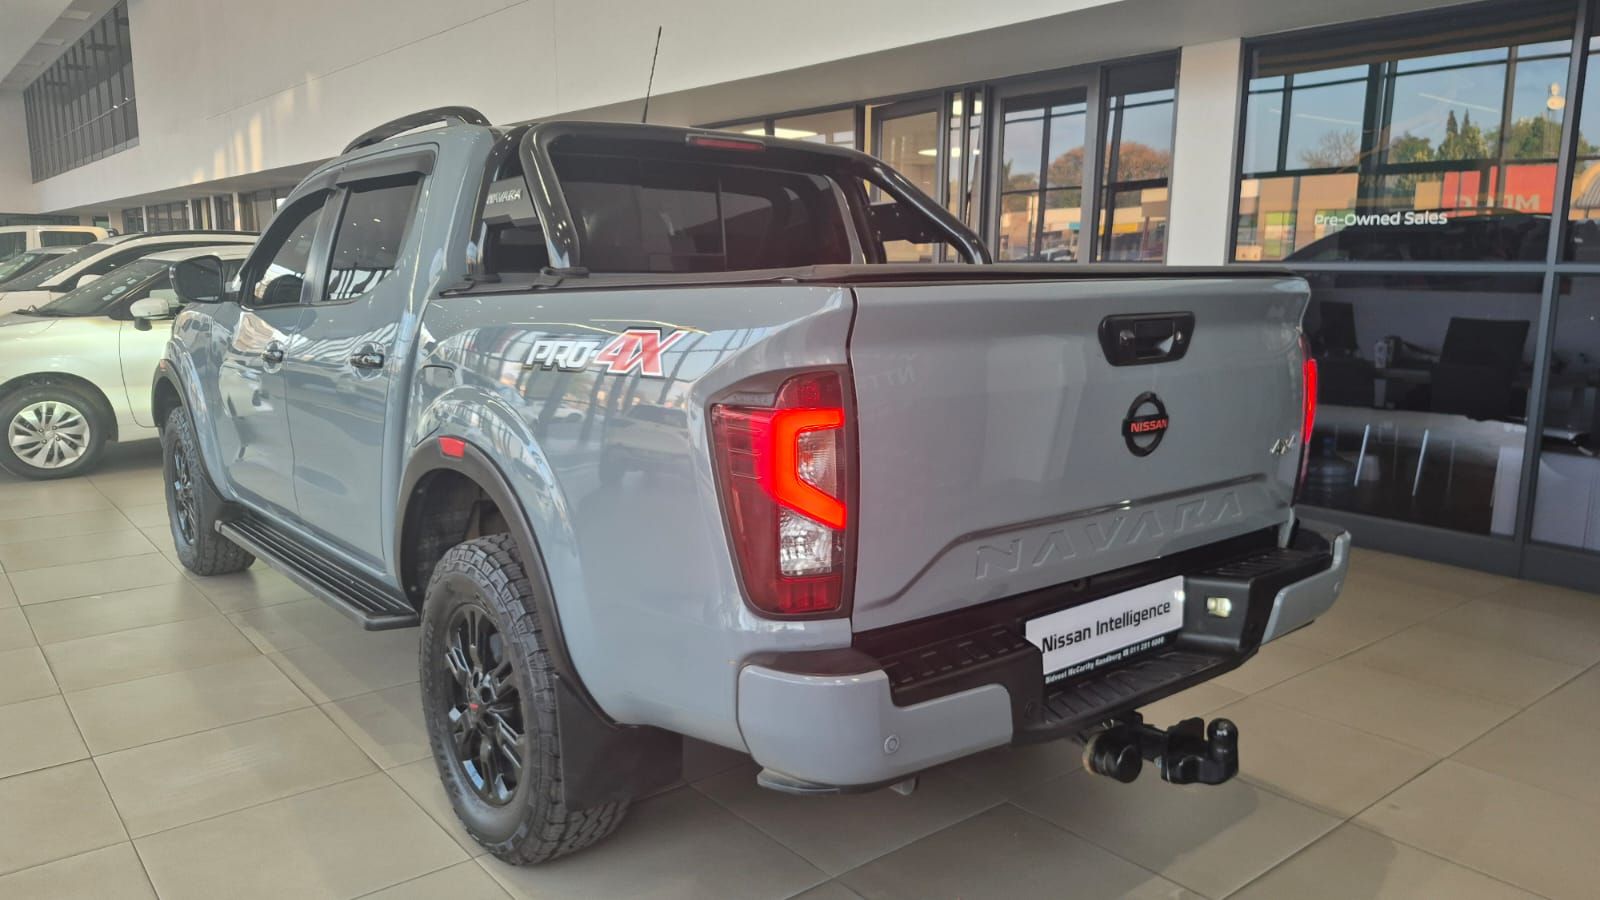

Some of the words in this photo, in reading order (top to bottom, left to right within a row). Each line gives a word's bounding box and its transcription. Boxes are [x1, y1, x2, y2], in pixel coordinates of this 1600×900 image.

[1314, 211, 1401, 226] Pre-Owned
[1404, 210, 1448, 225] Sales
[1130, 418, 1168, 433] NISSAN
[976, 490, 1242, 580] NAVARA
[1042, 626, 1091, 653] Nissan
[1096, 601, 1171, 637] Intelligence
